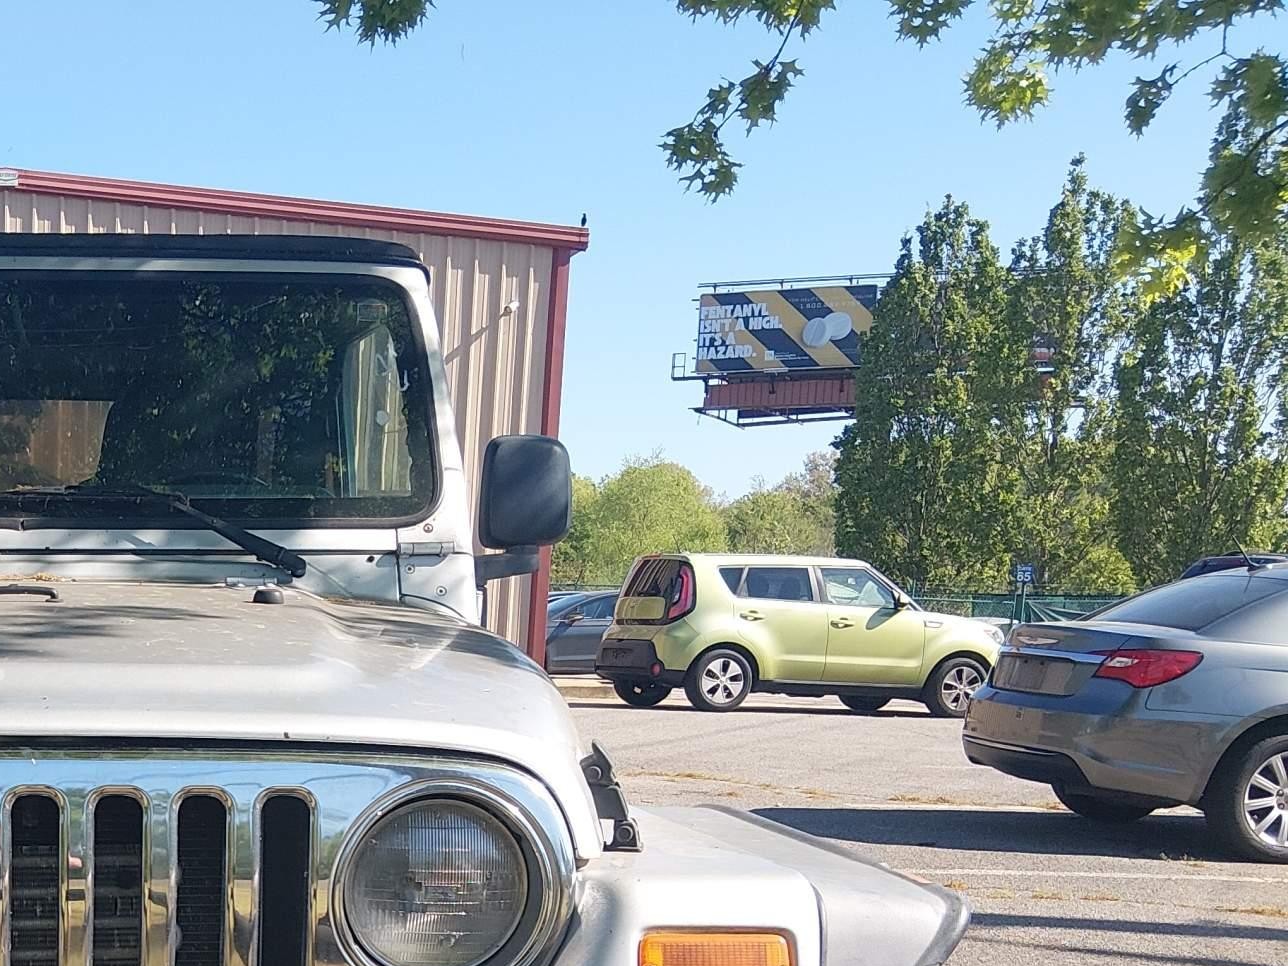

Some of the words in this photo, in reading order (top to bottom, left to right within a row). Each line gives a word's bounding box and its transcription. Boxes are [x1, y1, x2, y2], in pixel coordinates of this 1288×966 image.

[700, 303, 769, 320] FENTANYL
[700, 319, 732, 333] ISN'T
[735, 316, 746, 331] A
[748, 315, 783, 330] HIGH.
[699, 333, 723, 347] IT'S
[725, 331, 736, 345] A
[698, 344, 757, 360] HAZARD.
[1016, 571, 1032, 582] 65
